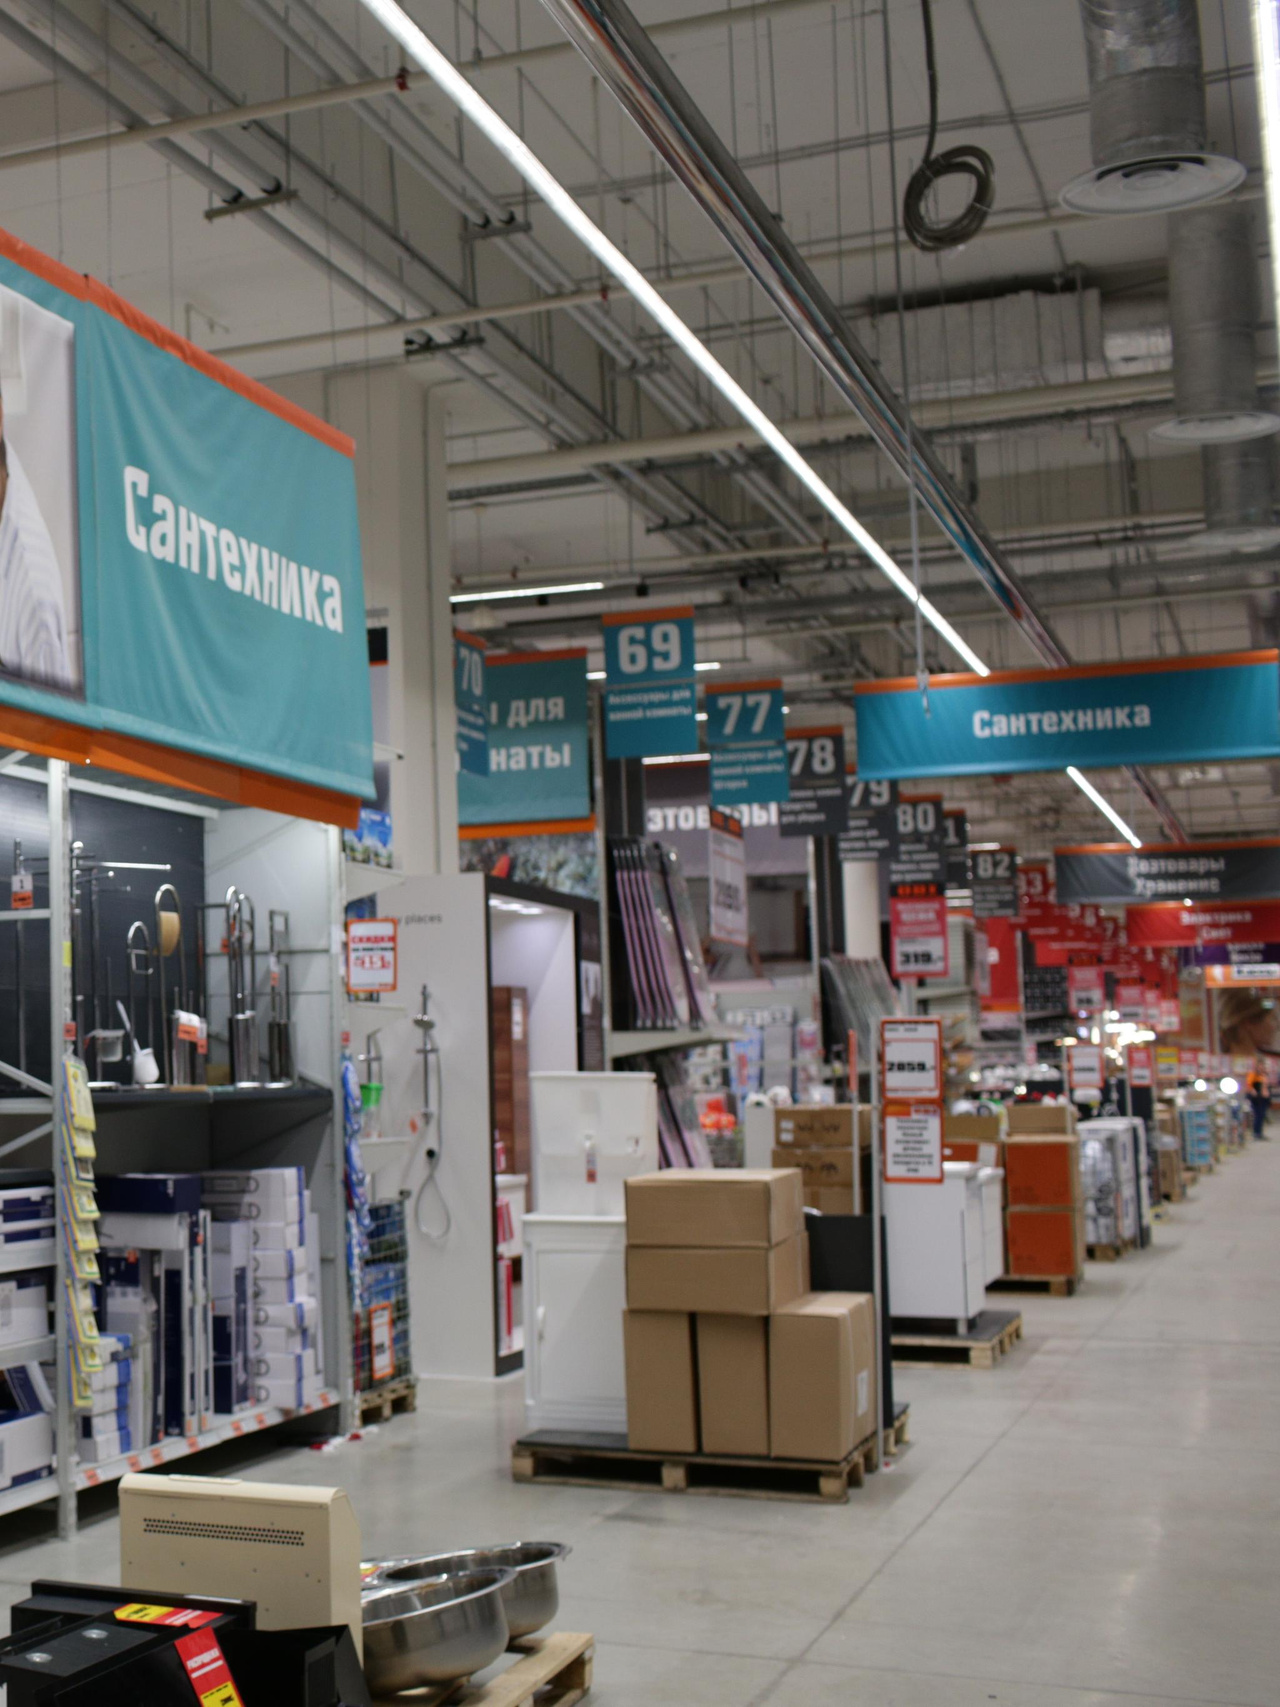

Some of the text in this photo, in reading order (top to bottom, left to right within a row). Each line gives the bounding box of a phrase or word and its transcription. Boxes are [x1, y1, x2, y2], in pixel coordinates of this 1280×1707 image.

[124, 465, 344, 634] Сантехника
[617, 623, 682, 674] 69
[460, 646, 483, 697] 70
[718, 693, 772, 735] 77
[973, 702, 1151, 739] Сантехника
[786, 737, 836, 776] 78
[845, 774, 891, 807] 79
[897, 802, 936, 834] 80
[976, 852, 1011, 879] 82
[1126, 855, 1225, 877] Хозтовары
[1134, 876, 1221, 899] Хранение
[1180, 910, 1253, 929] Электрика
